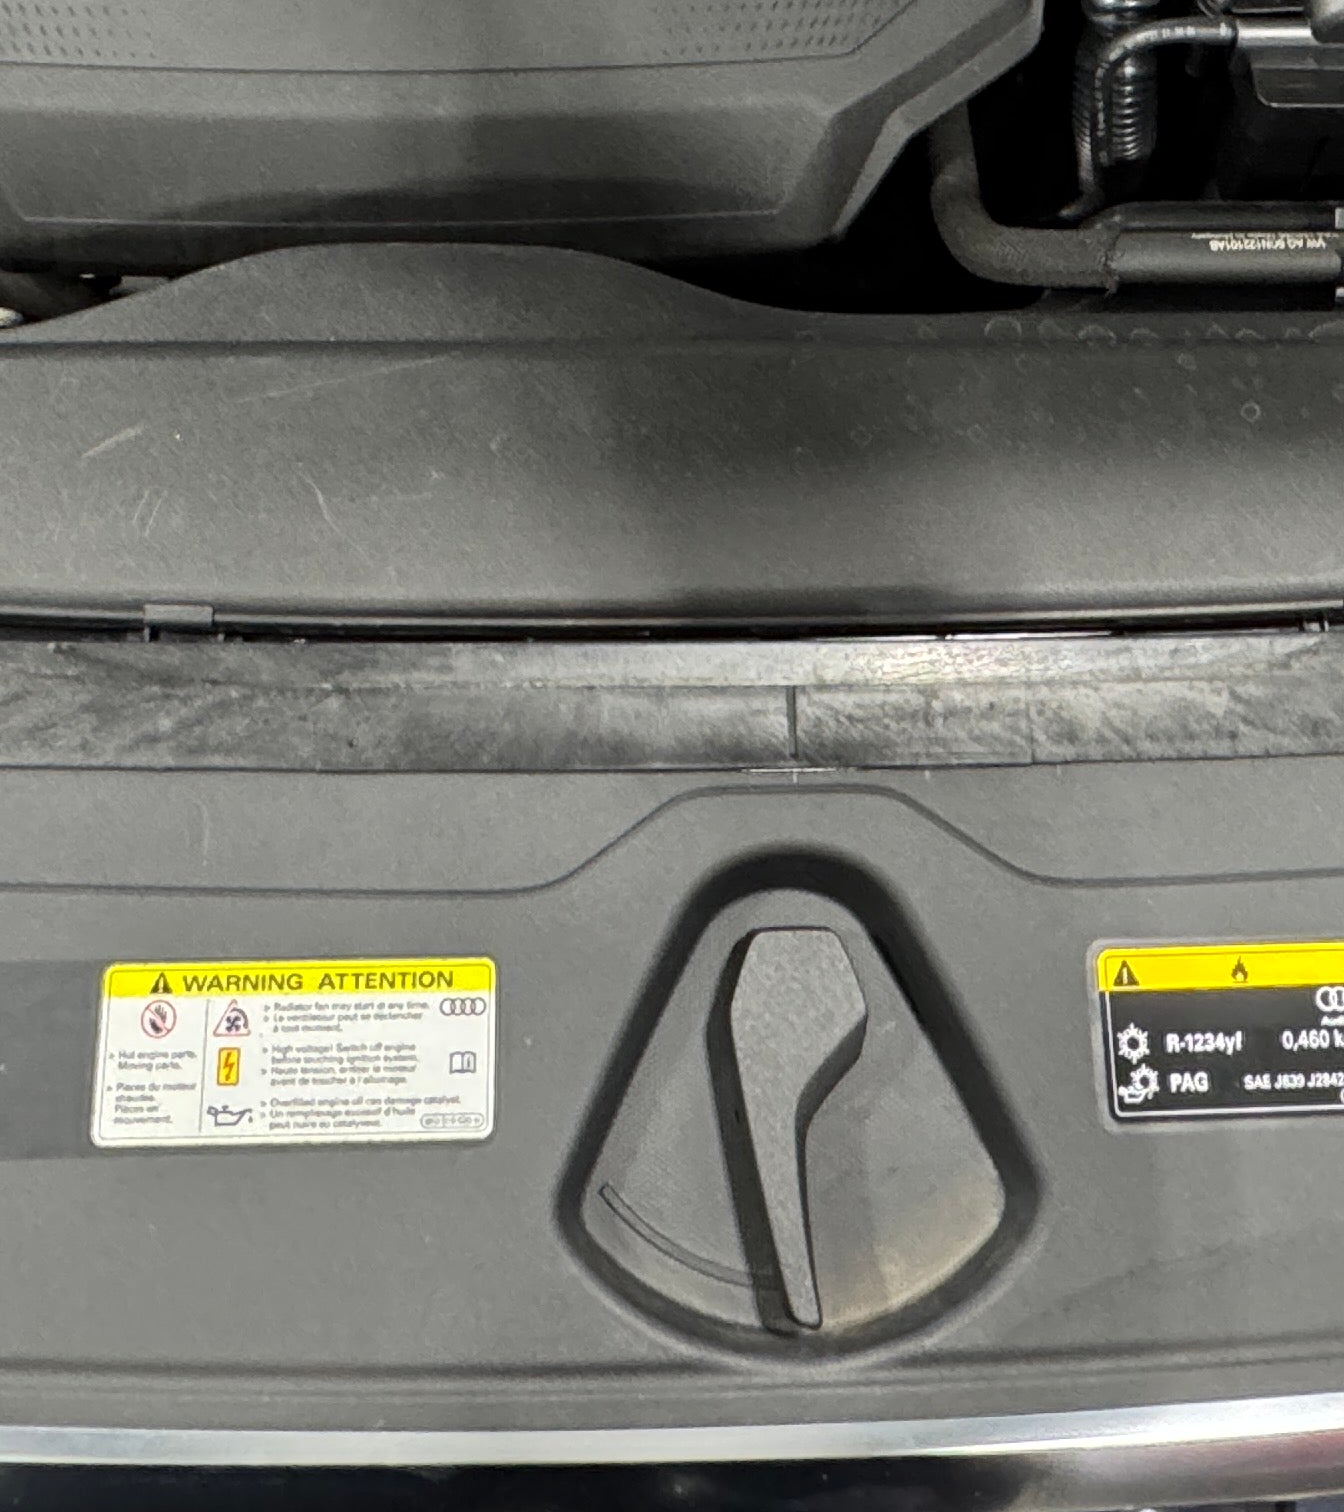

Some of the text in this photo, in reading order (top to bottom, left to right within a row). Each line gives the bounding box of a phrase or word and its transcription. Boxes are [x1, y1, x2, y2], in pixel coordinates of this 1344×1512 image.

[183, 970, 454, 992] WARNING ATTENTION
[1282, 1029, 1330, 1052] 0,460
[1169, 1071, 1209, 1094] PAG
[1243, 1073, 1272, 1090] SAE
